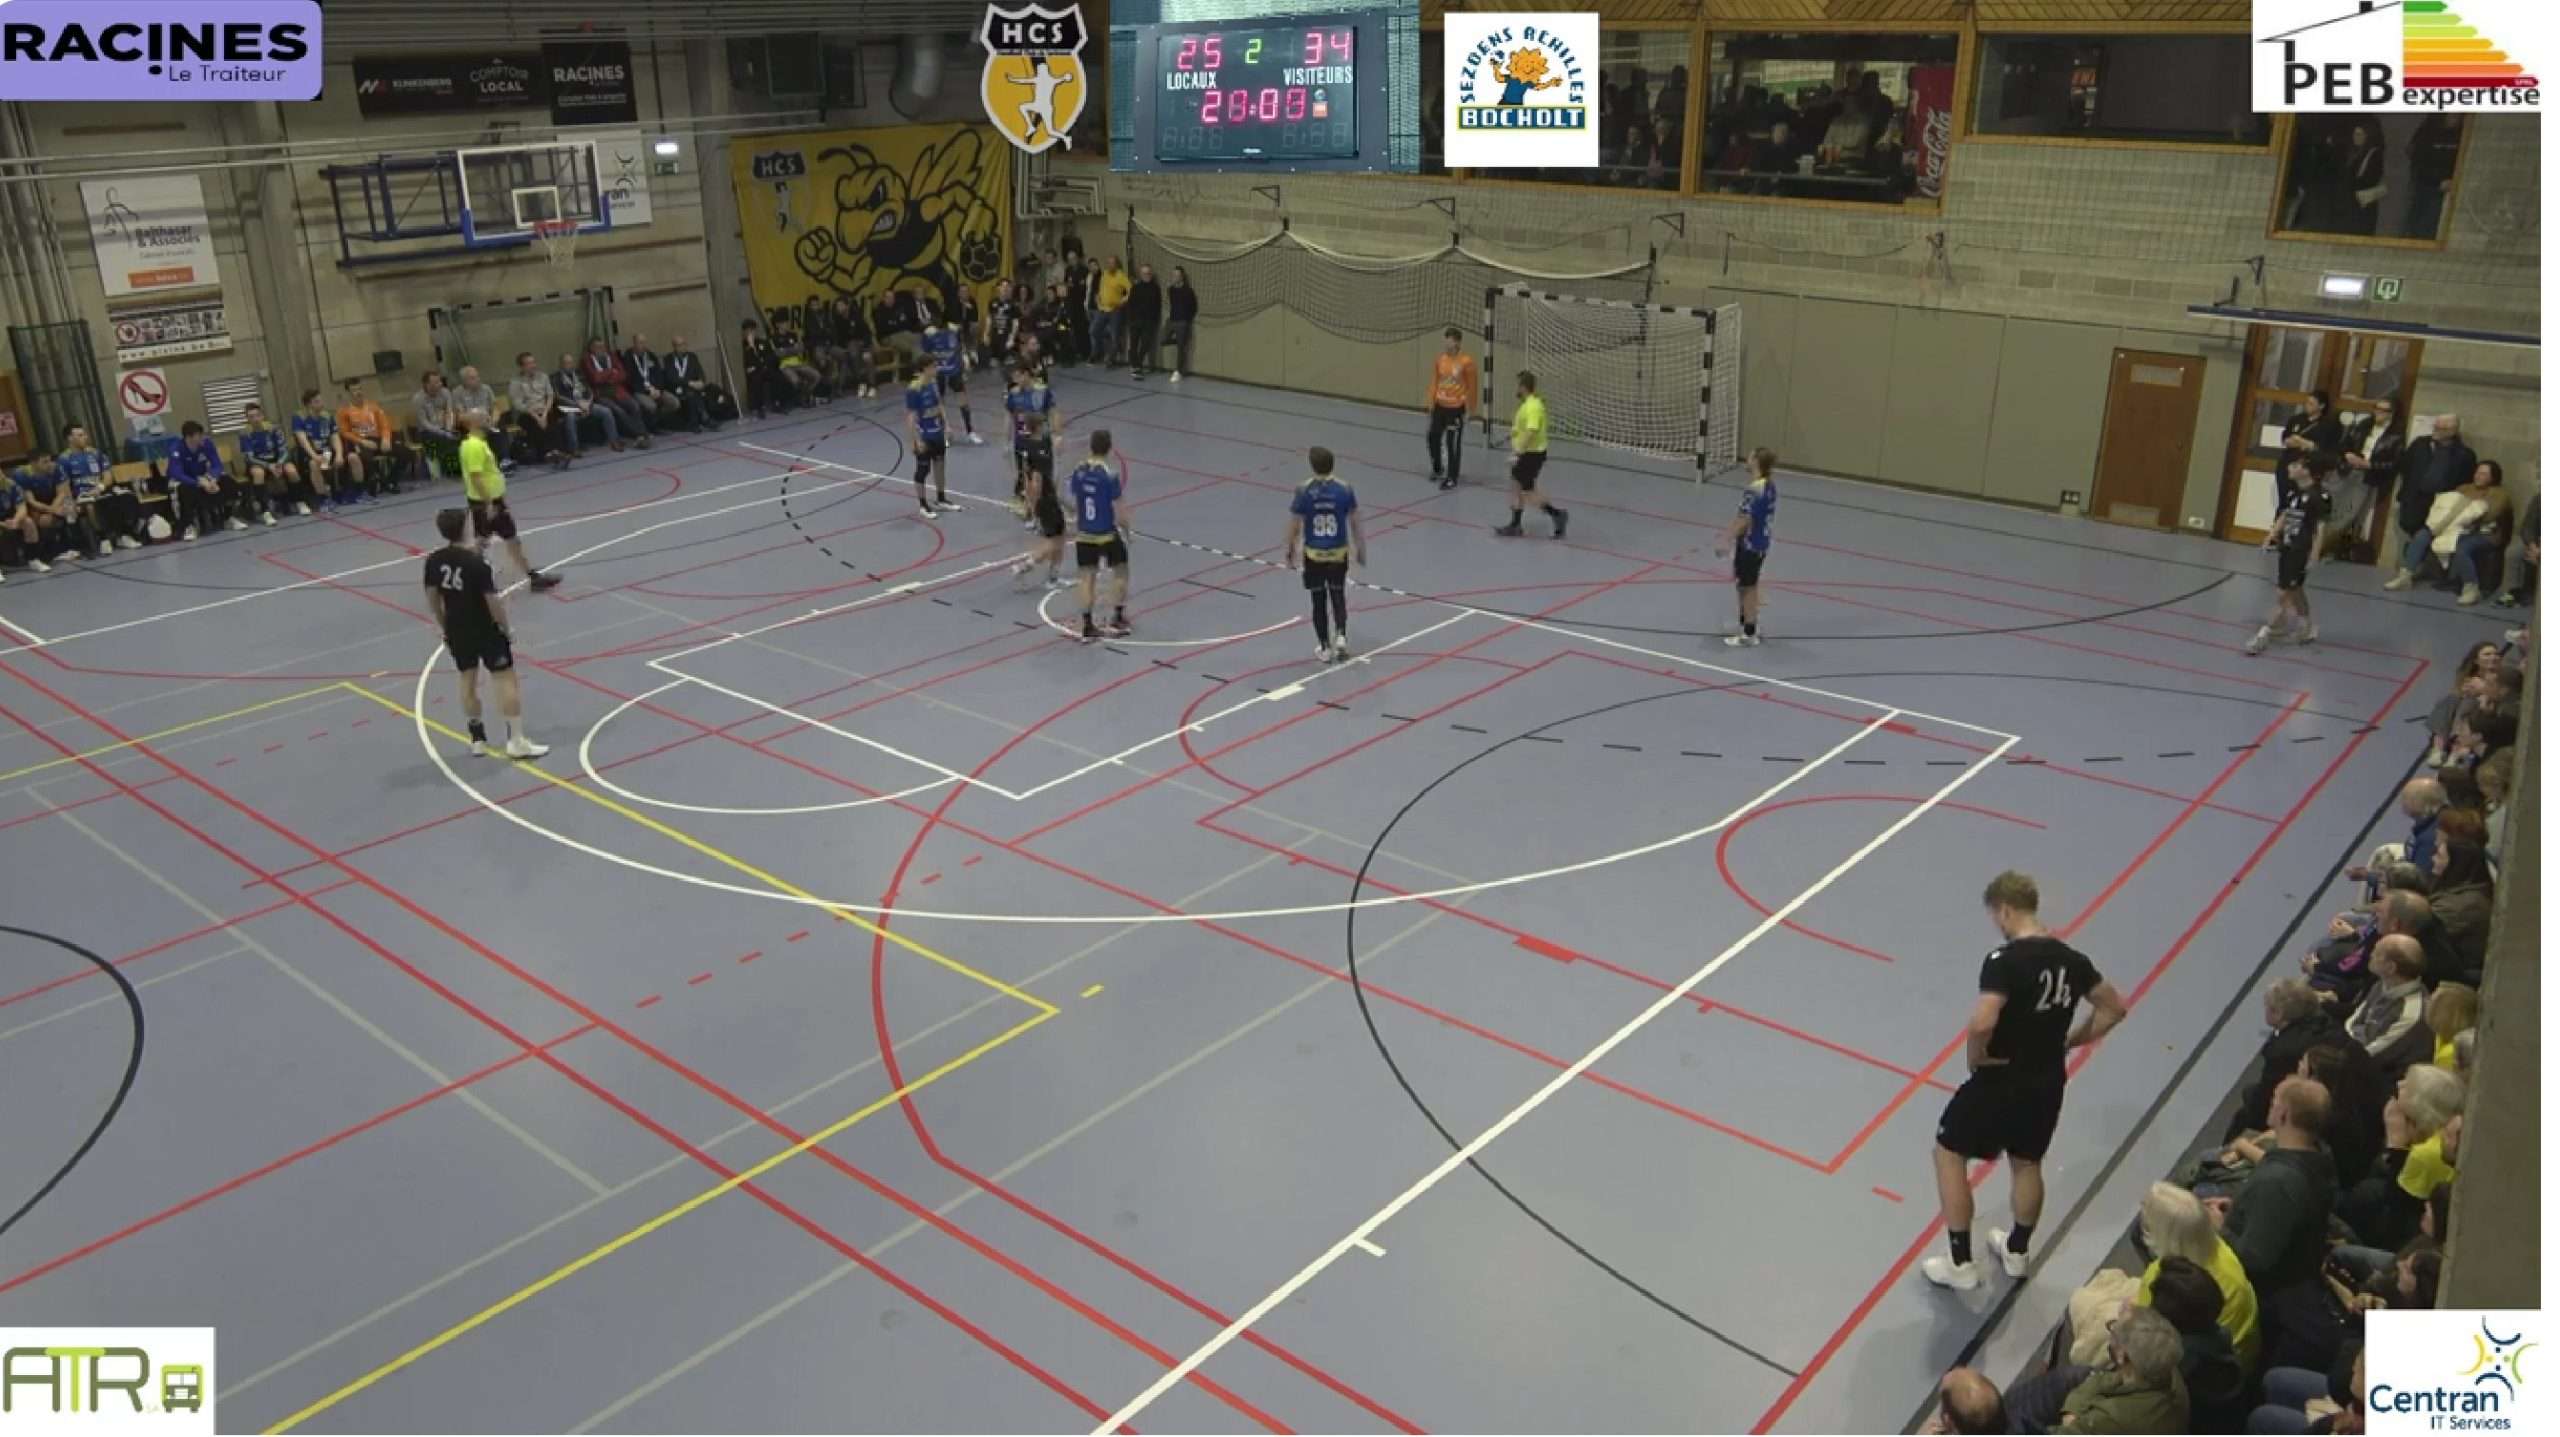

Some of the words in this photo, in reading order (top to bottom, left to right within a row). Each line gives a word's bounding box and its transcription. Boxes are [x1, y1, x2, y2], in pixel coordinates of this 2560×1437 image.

[1178, 38, 1221, 69] 25
[1245, 38, 1262, 64] 2
[1304, 32, 1350, 63] 34
[480, 80, 524, 93] LOCAL
[553, 64, 625, 85] RACINES
[1166, 71, 1217, 90] LOCAUX
[1283, 66, 1354, 85] VISITEURS
[761, 157, 796, 176] HCS
[1085, 496, 1097, 521] 6
[1312, 513, 1338, 537] 98
[440, 564, 464, 591] 26
[2035, 966, 2072, 1011] 24
